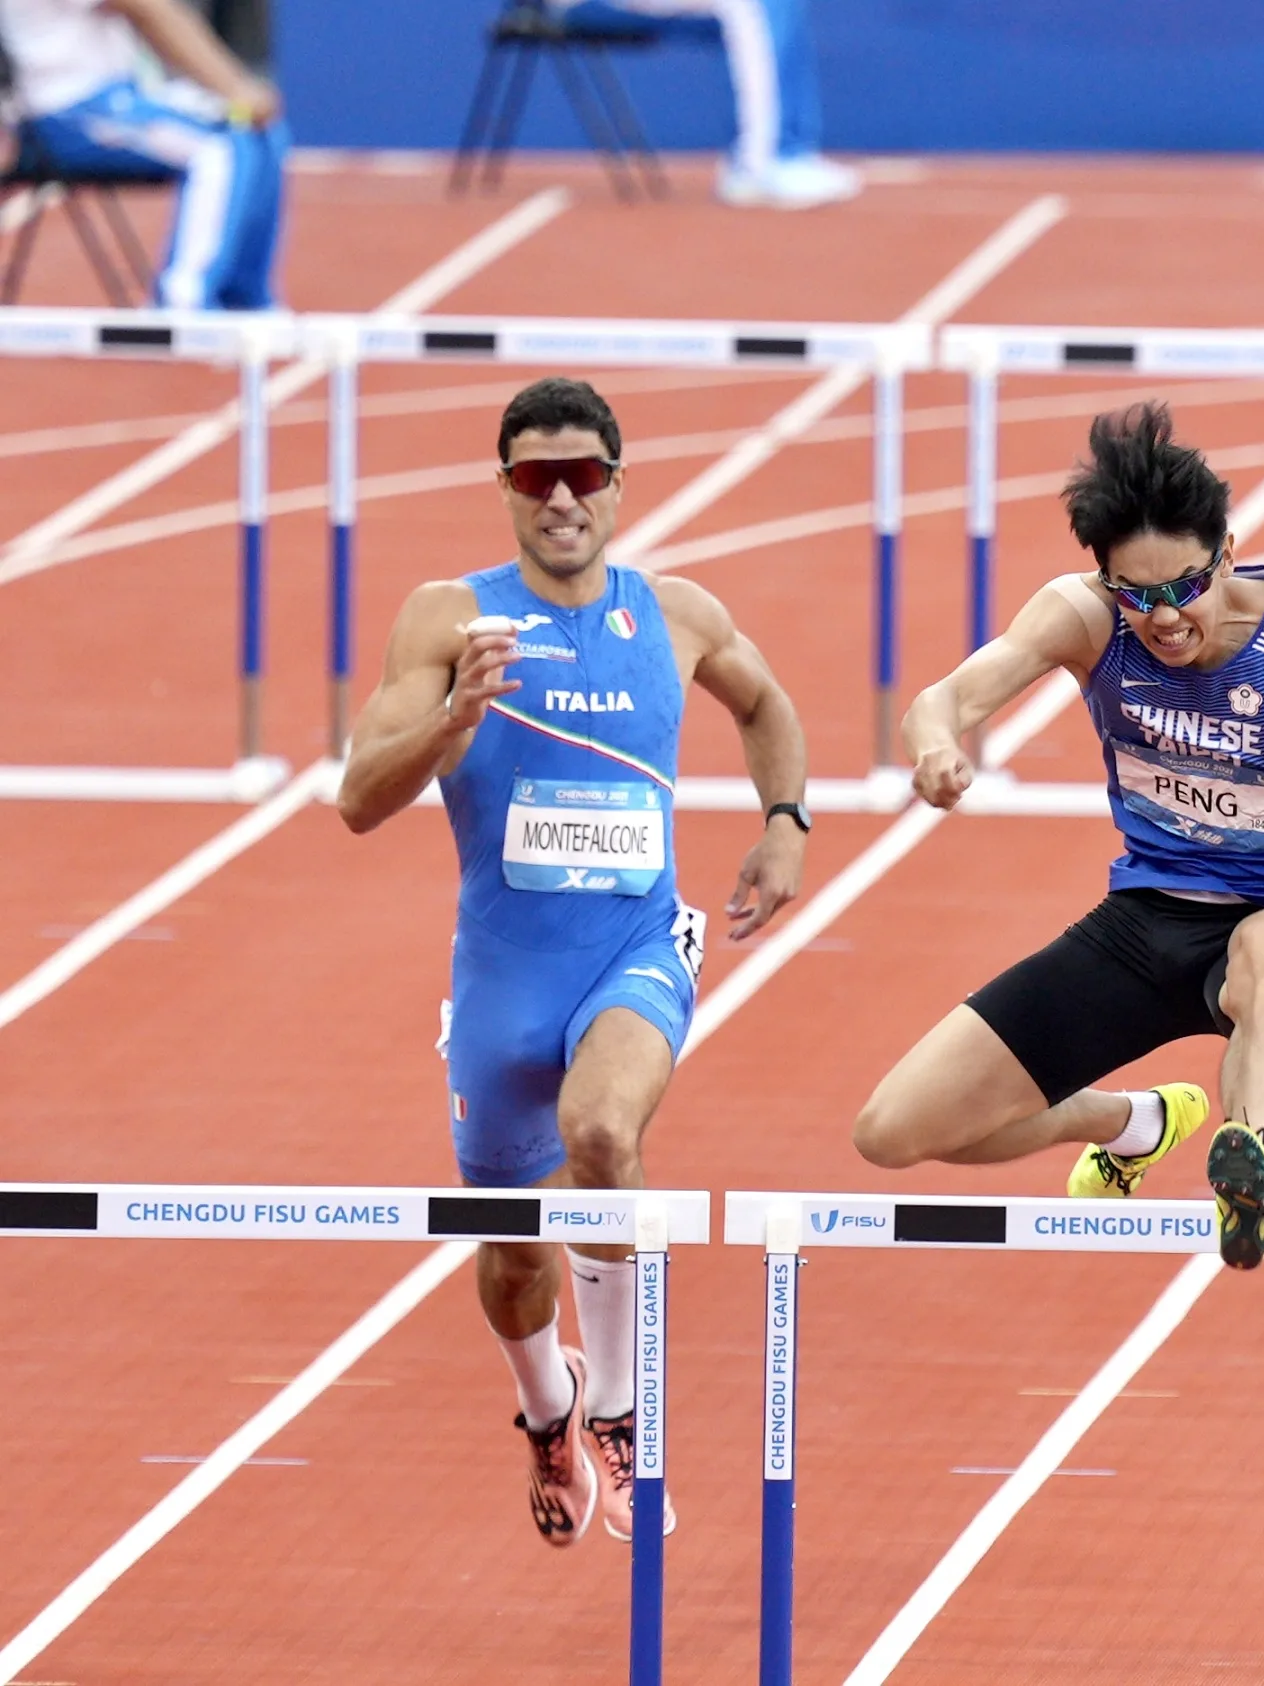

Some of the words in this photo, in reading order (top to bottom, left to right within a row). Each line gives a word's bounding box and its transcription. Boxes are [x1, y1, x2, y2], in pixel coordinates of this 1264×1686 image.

[545, 689, 636, 713] ITALIA
[1120, 702, 1262, 755] CHINESE
[1160, 755, 1210, 770] CHENGDU
[1213, 764, 1234, 776] 2021
[1154, 775, 1238, 817] PENG
[522, 820, 649, 854] MONTEFALCONE
[126, 1201, 246, 1223] CHENGDU
[253, 1204, 307, 1224] FISU
[314, 1204, 401, 1225] GAMES
[547, 1211, 627, 1226] FISU.TV
[841, 1215, 887, 1228] FISU
[1034, 1215, 1153, 1236] CHENGDU
[1160, 1217, 1212, 1238] FISU
[643, 1262, 658, 1327] GAMES
[774, 1264, 789, 1329] GAMES
[643, 1333, 658, 1373] FISU
[773, 1335, 787, 1375] FISU
[643, 1378, 658, 1469] CHENGDU
[771, 1380, 787, 1470] CHENGDU
